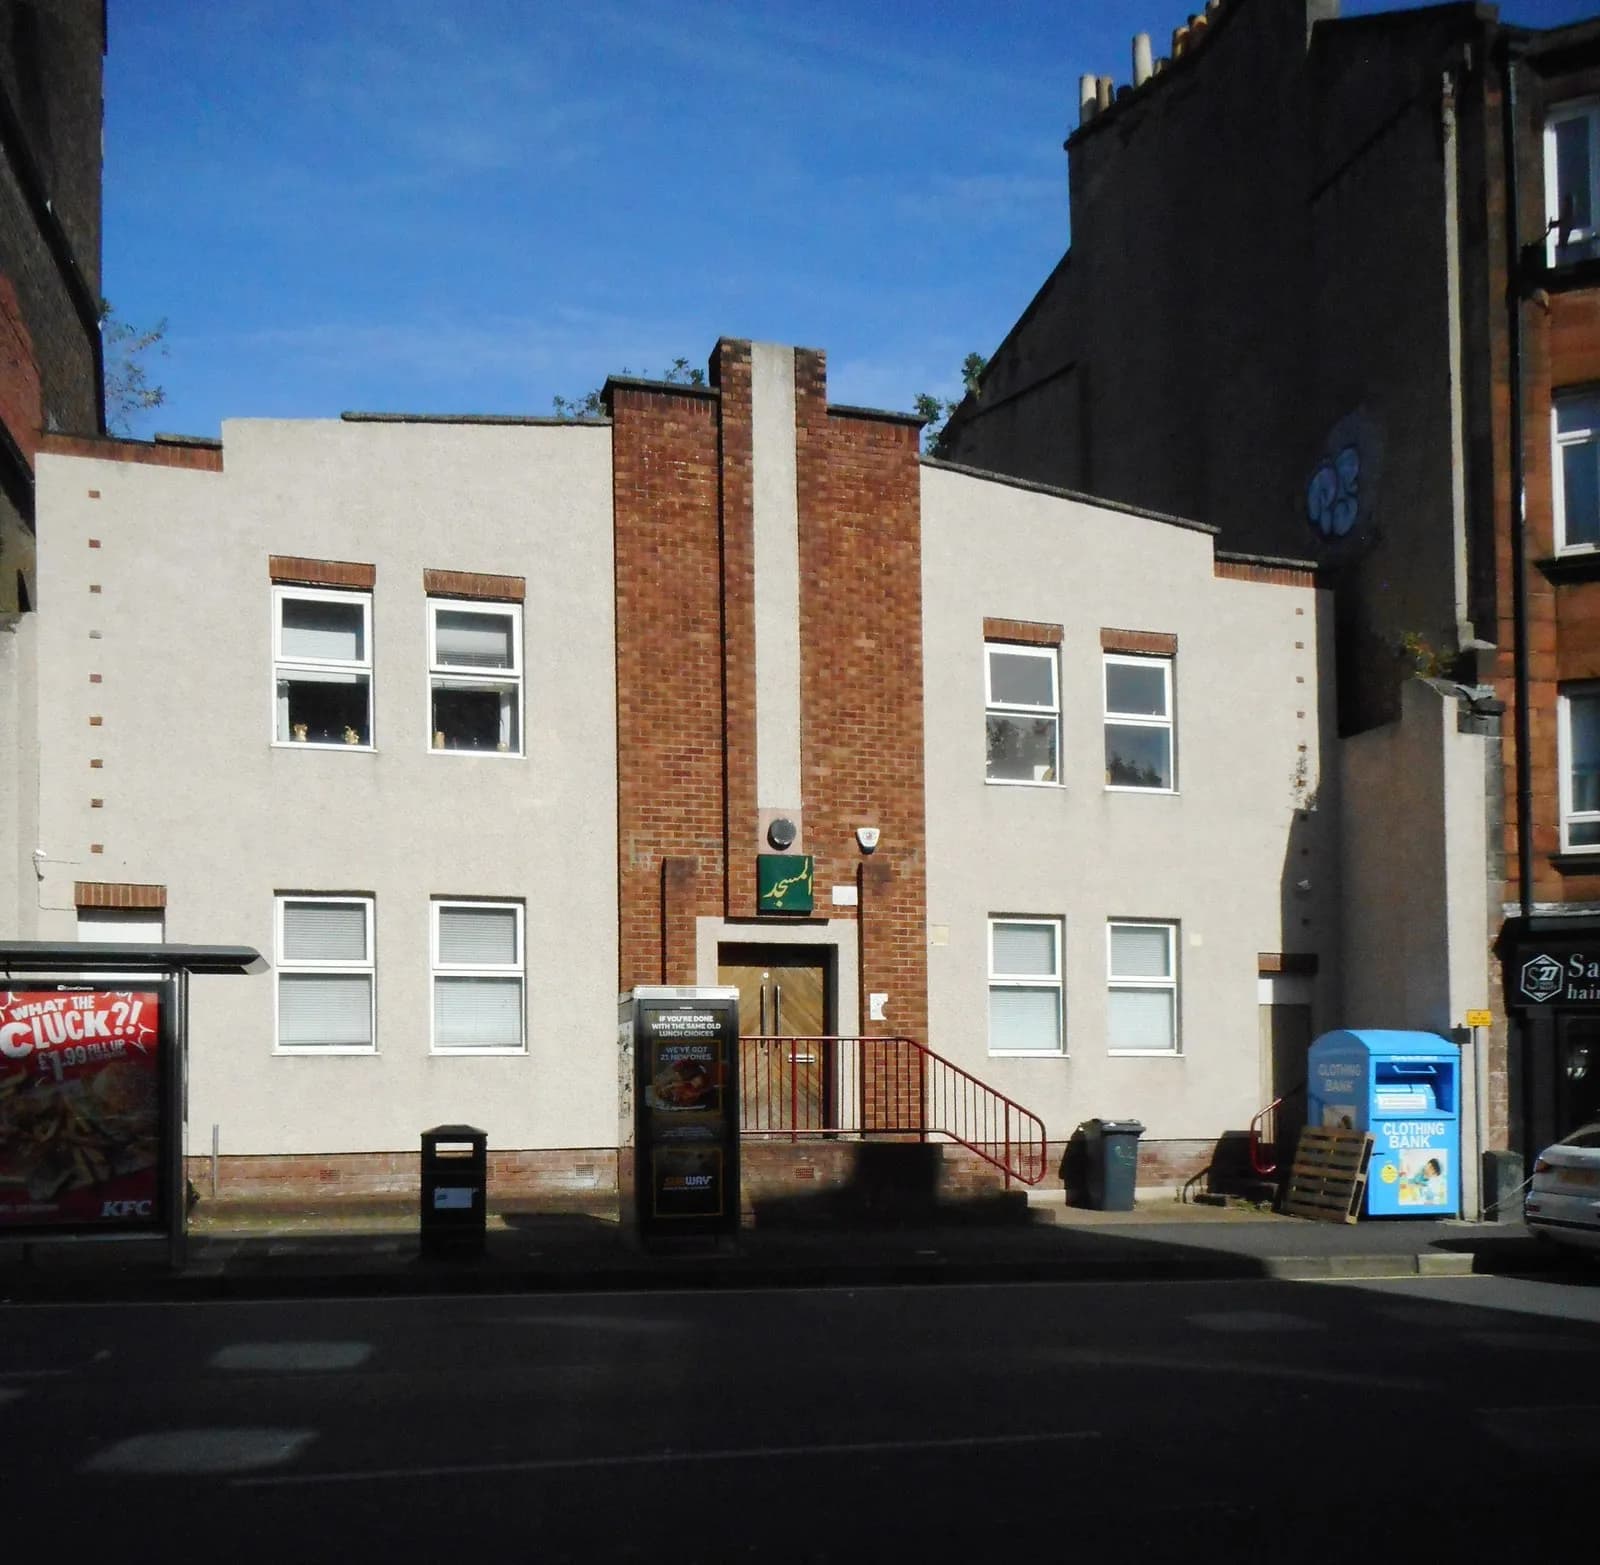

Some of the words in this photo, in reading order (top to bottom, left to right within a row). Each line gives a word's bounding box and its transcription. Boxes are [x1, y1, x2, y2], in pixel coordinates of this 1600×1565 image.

[1539, 966, 1559, 981] 27
[11, 998, 67, 1021] WHAT
[71, 995, 95, 1010] THE
[0, 1000, 144, 1058] CLUCK?!
[38, 1046, 87, 1080] £1.99
[1318, 1064, 1361, 1076] CLOTHING
[1383, 1122, 1444, 1135] CLOTHING
[1389, 1136, 1430, 1148] BANK
[102, 1200, 152, 1217] KFC
